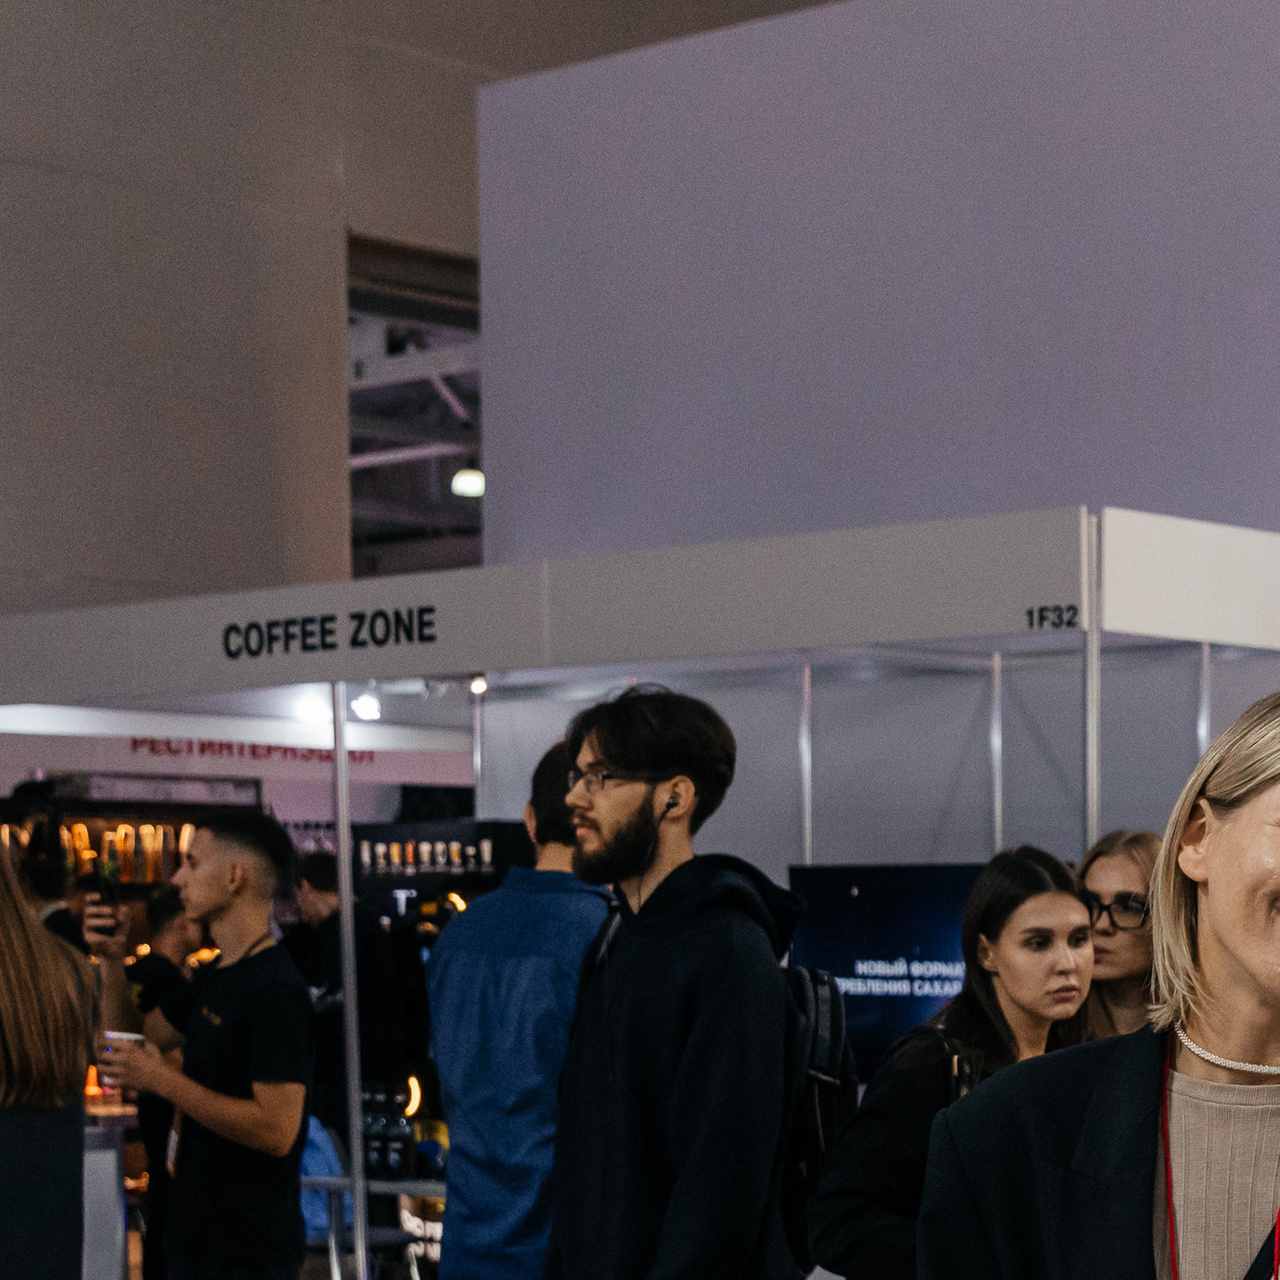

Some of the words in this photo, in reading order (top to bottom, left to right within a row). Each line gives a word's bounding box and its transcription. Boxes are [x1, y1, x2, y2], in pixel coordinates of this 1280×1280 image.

[1026, 604, 1078, 629] 1F32
[223, 614, 338, 660] COFFEE
[349, 605, 437, 648] ZONE
[854, 957, 908, 977] НОВЫЙ
